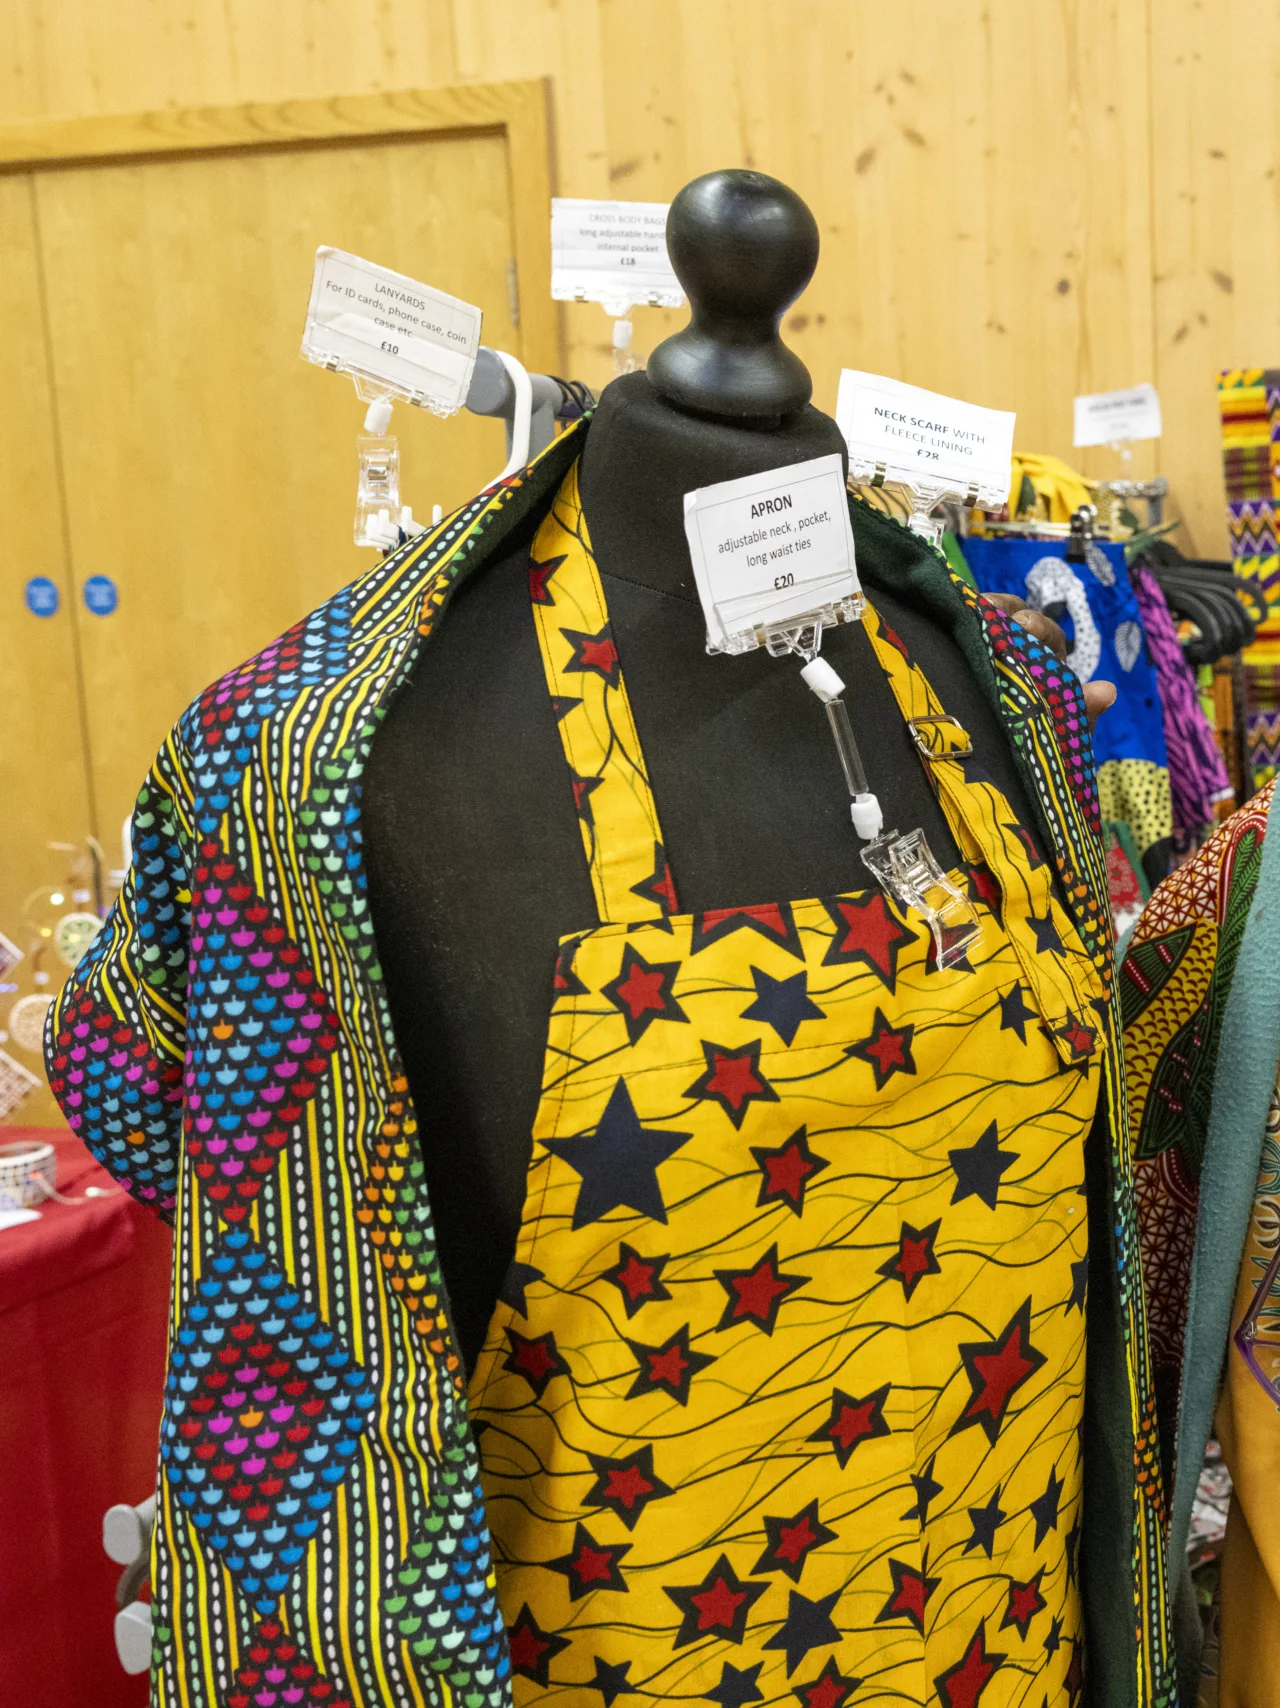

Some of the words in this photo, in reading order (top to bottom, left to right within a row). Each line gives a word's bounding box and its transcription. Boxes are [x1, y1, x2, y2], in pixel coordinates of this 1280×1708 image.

[588, 214, 616, 224] CROSS
[618, 215, 641, 225] BODY
[579, 228, 597, 239] long
[599, 228, 642, 239] adjustable
[596, 243, 629, 252] internal
[631, 244, 659, 254] pocket
[620, 257, 636, 266] £18
[374, 282, 426, 311] LANYARDS
[326, 280, 343, 293] For
[345, 287, 356, 299] ID
[357, 293, 386, 313] cards,
[388, 305, 419, 325] phone
[421, 316, 445, 336] case,
[447, 331, 467, 345] coin
[374, 316, 396, 331] case
[397, 327, 415, 339] etc.
[380, 341, 399, 355] £10
[873, 406, 907, 424] NECK
[910, 416, 949, 434] SCARF
[952, 428, 985, 445] WITH
[884, 424, 927, 444] FLEECE
[931, 437, 973, 456] LINING
[916, 449, 940, 460] £28
[750, 494, 793, 520] APRON
[718, 529, 768, 554] adjustable
[769, 521, 792, 538] neck
[798, 510, 832, 532] pocket,
[746, 553, 768, 568] long
[769, 545, 794, 560] waist
[794, 538, 812, 552] ties
[774, 572, 794, 591] £20
